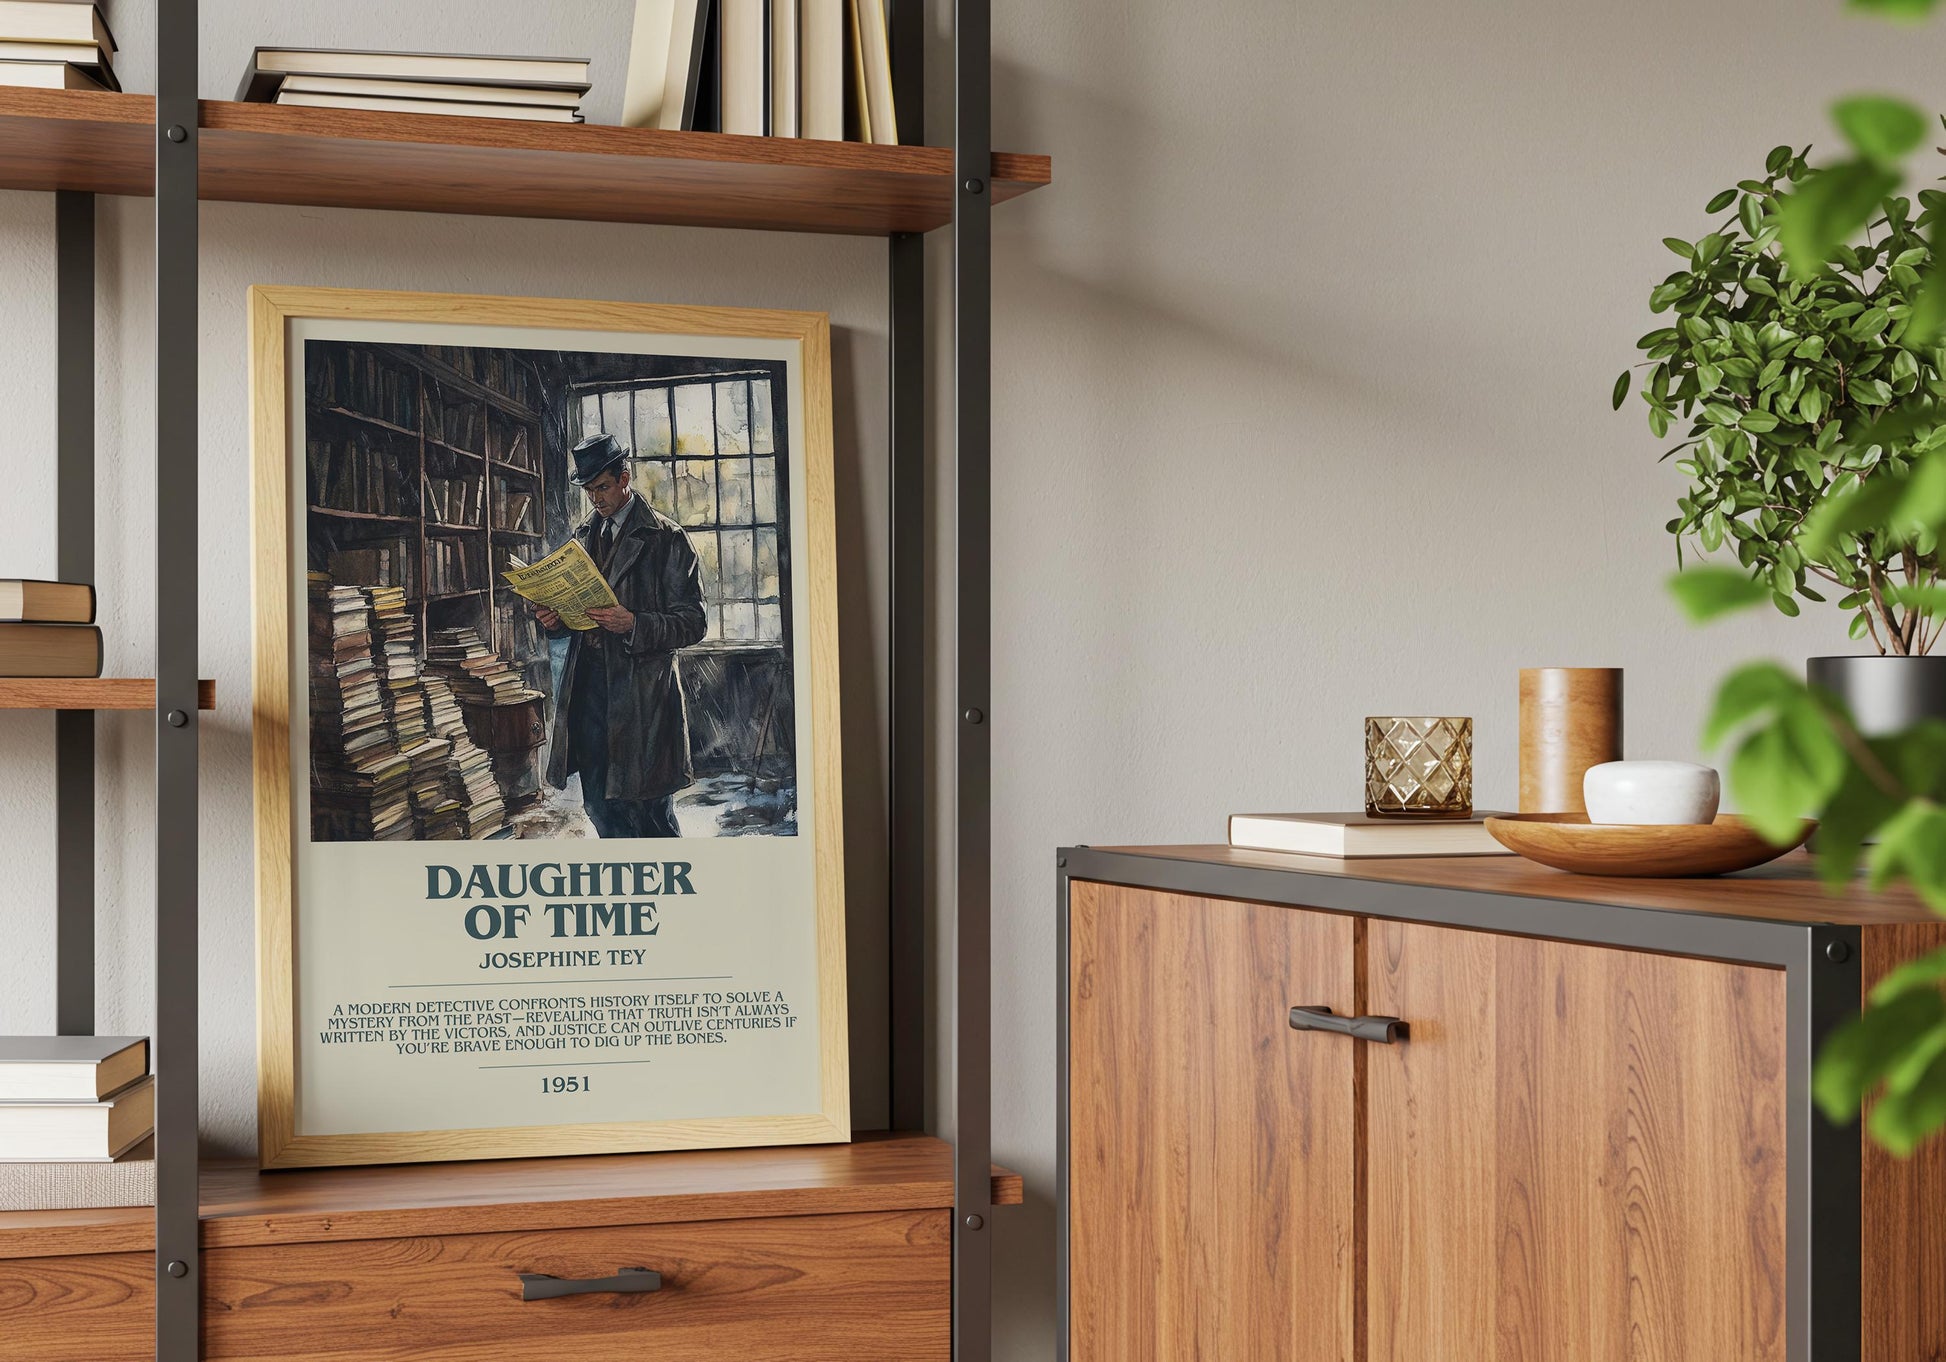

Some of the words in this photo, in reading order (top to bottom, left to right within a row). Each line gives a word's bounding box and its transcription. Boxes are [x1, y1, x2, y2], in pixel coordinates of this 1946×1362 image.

[425, 861, 697, 900] DAUGHTER
[464, 904, 532, 940] OF
[543, 901, 660, 938] TIME
[478, 950, 602, 969] JOSEPHINE
[606, 949, 647, 966] TEY
[328, 1015, 396, 1030] MYSTERY
[397, 1014, 441, 1028] FROM
[443, 1013, 473, 1027] THE
[607, 1008, 645, 1021] THAT
[646, 1006, 693, 1020] TRUTH
[696, 1005, 732, 1018] ISN'T
[733, 1003, 790, 1018] ALWAYS
[333, 1004, 344, 1017] A
[347, 1002, 412, 1017] MODERN
[416, 999, 495, 1014] DETECTIVE
[498, 996, 586, 1011] CONFRONTS
[590, 995, 651, 1009] HISTORY
[652, 993, 700, 1007] ITSELF
[702, 992, 722, 1005] TO
[725, 991, 772, 1004] SOLVE
[774, 991, 784, 1003] A
[320, 1030, 385, 1044] WRITTEN
[388, 1028, 408, 1042] BY
[410, 1028, 441, 1041] THE
[444, 1025, 512, 1040] VICTORS,
[516, 1024, 546, 1038] AND
[548, 1022, 608, 1037] JUSTICE
[610, 1021, 640, 1034] CAN
[643, 1019, 703, 1033] OUTLIVE
[706, 1017, 781, 1031] CENTURIES
[785, 1016, 798, 1028] IF
[396, 1041, 450, 1055] YOU'RE
[453, 1039, 501, 1053] BRAVE
[505, 1036, 566, 1051] ENOUGH
[569, 1036, 590, 1049] TO
[594, 1035, 620, 1048] DIG
[623, 1034, 642, 1047] UP
[644, 1033, 673, 1046] THE
[676, 1031, 727, 1045] BONES.
[542, 1076, 590, 1094] 1951
